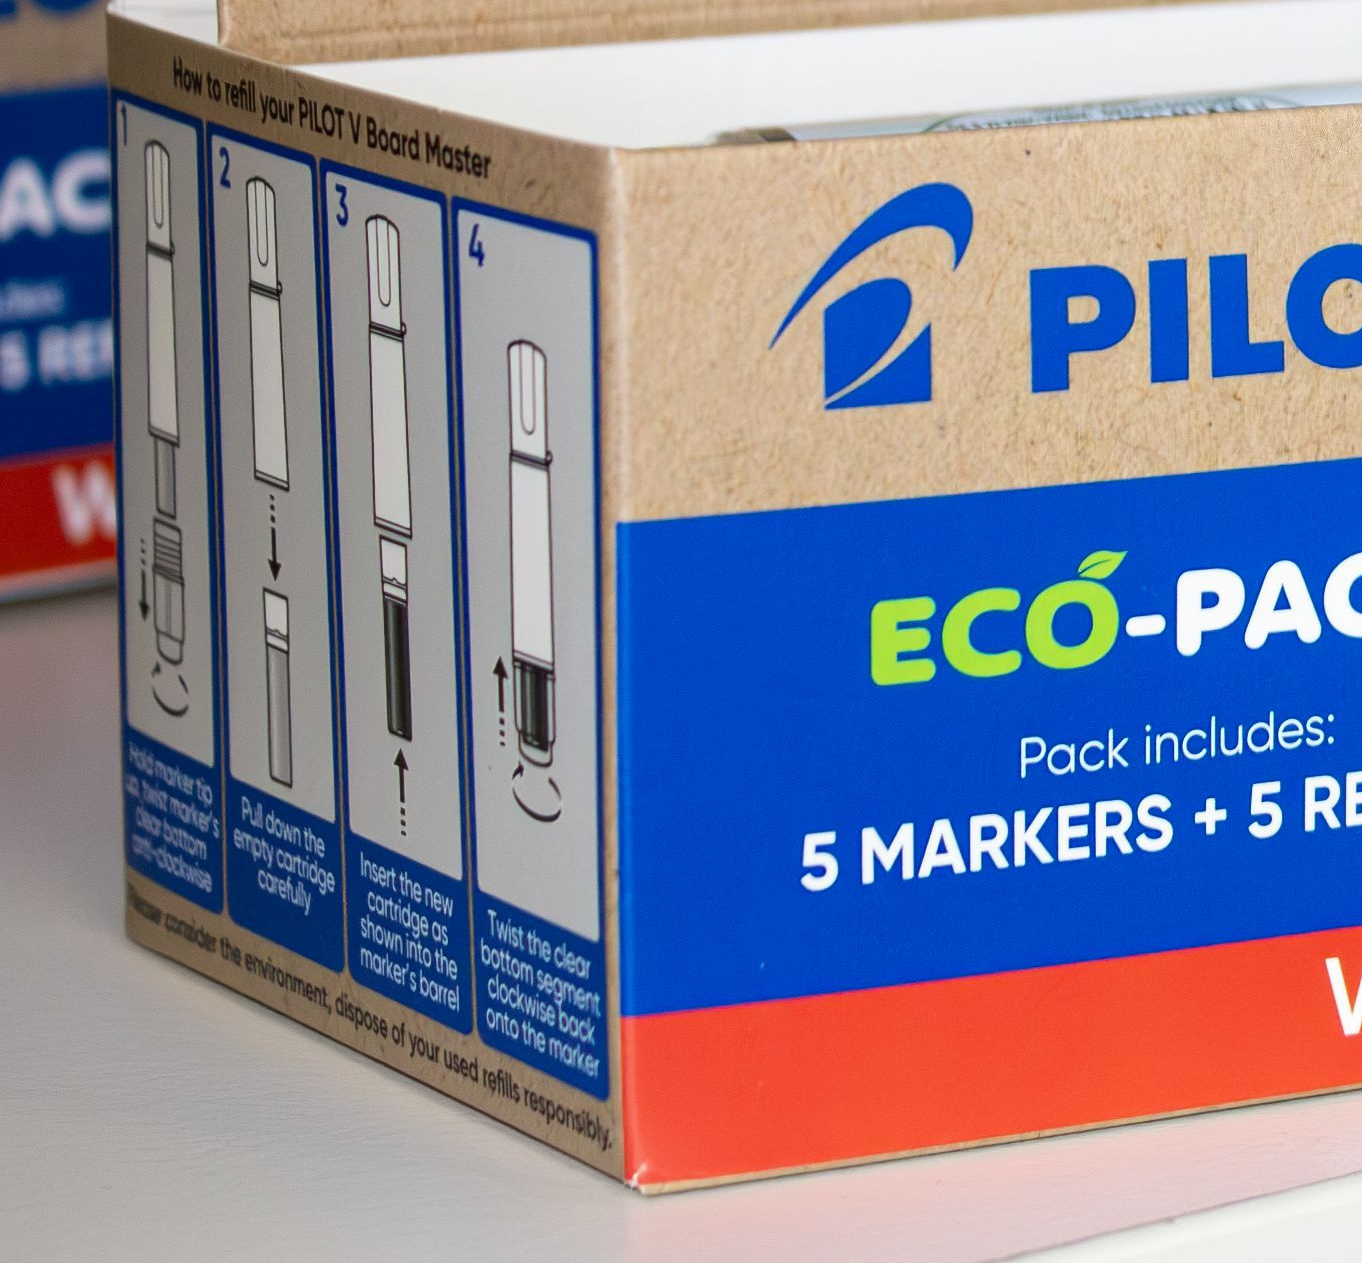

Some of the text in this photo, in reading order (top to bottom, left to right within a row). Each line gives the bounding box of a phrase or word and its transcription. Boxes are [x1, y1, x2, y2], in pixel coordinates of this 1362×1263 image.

[173, 56, 492, 180] How to refill your PILOT V Board Master
[219, 146, 231, 189] 2
[335, 183, 349, 228] 3
[467, 223, 486, 268] 4
[1019, 710, 1336, 778] Pack includes:
[241, 795, 326, 858] Pull down the
[801, 831, 838, 891] 5
[862, 794, 1173, 885] MARKERS
[1194, 797, 1228, 836] +
[1248, 781, 1284, 840] 5
[233, 827, 336, 896] empty cartridge
[257, 868, 312, 916] carefully
[360, 851, 454, 917] Insert the new
[360, 917, 458, 981] shown into the
[367, 890, 449, 946] cartridge as
[487, 909, 591, 980] Twist the clear
[360, 945, 460, 1013] marker's barrel
[481, 937, 534, 986] bottom
[220, 937, 242, 968] the
[244, 954, 333, 1014] environment,
[335, 991, 389, 1038] dispose
[392, 1022, 405, 1047] of
[408, 1031, 440, 1064] your
[443, 1050, 479, 1084] used
[482, 1067, 521, 1104] refills
[523, 1086, 613, 1151] responsibly.
[486, 1006, 601, 1079] onto the marker
[487, 976, 596, 1046] clockwise back
